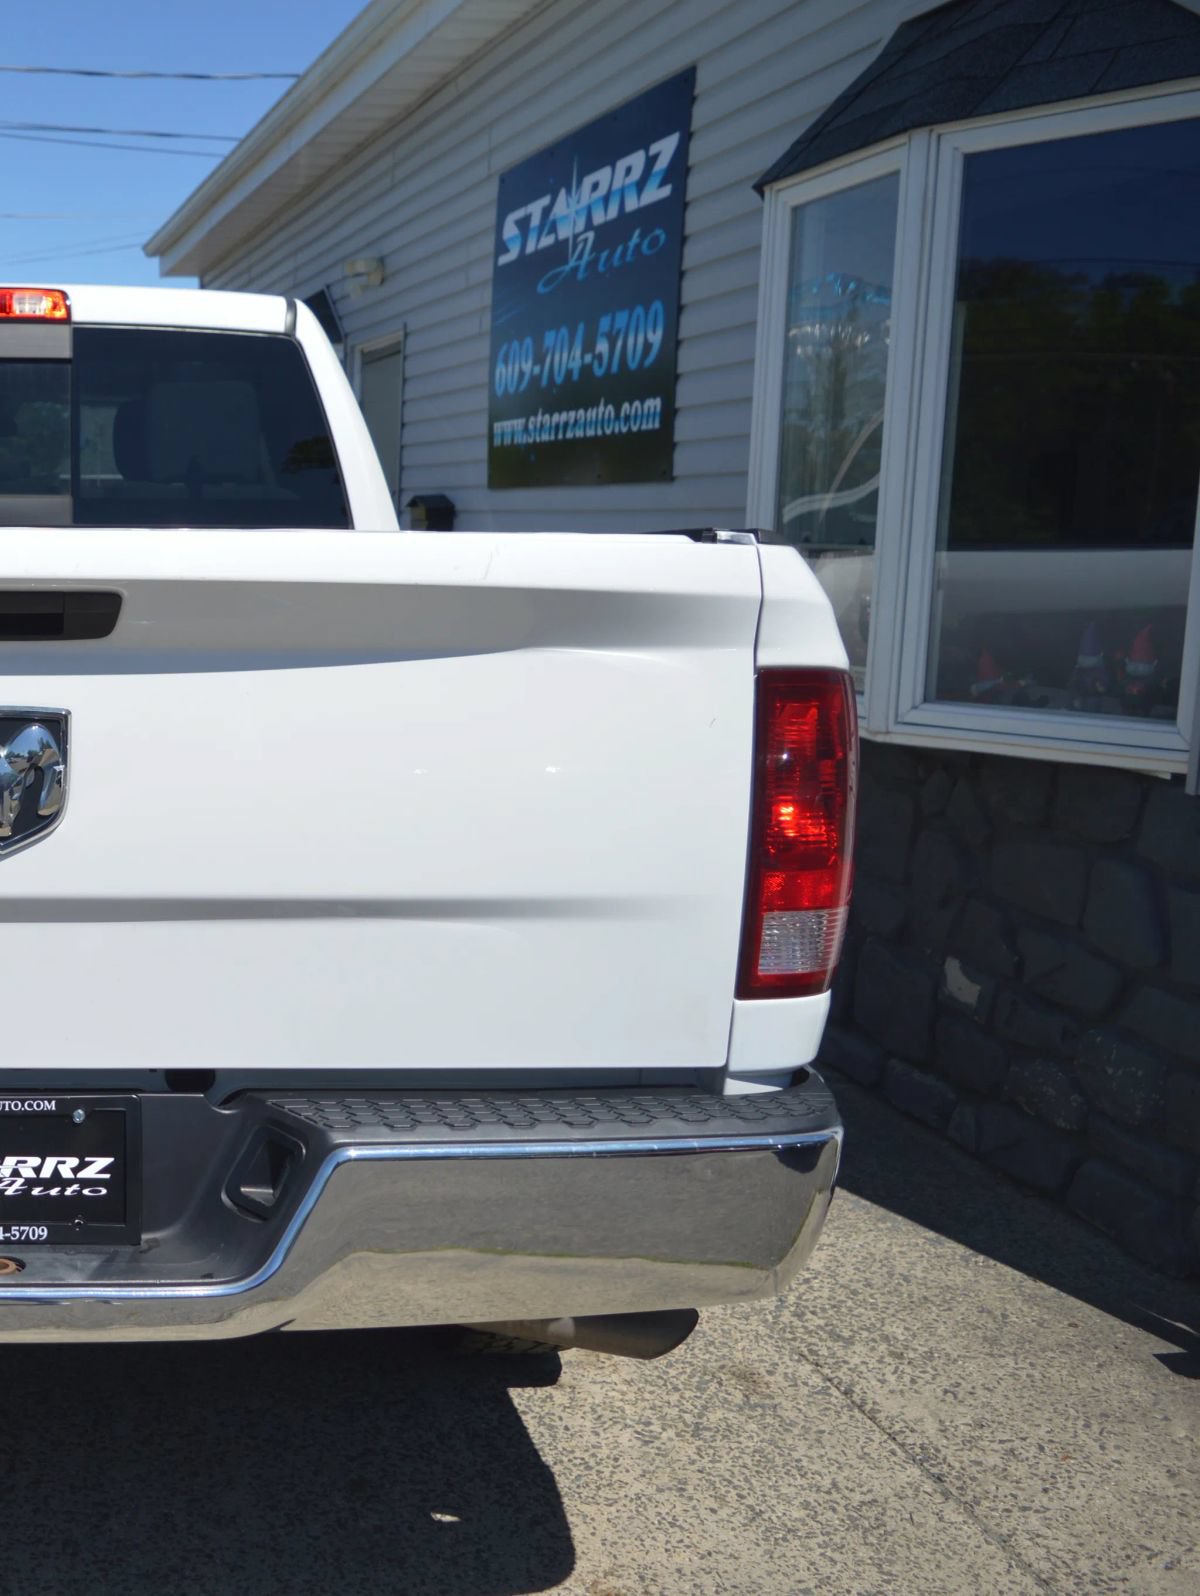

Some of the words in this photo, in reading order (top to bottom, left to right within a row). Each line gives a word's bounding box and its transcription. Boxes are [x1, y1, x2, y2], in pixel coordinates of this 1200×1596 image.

[498, 131, 680, 266] STARRZ
[536, 227, 666, 294] Auto
[495, 299, 664, 397] 609-704-5709
[493, 397, 661, 447] www.starrzauto.com
